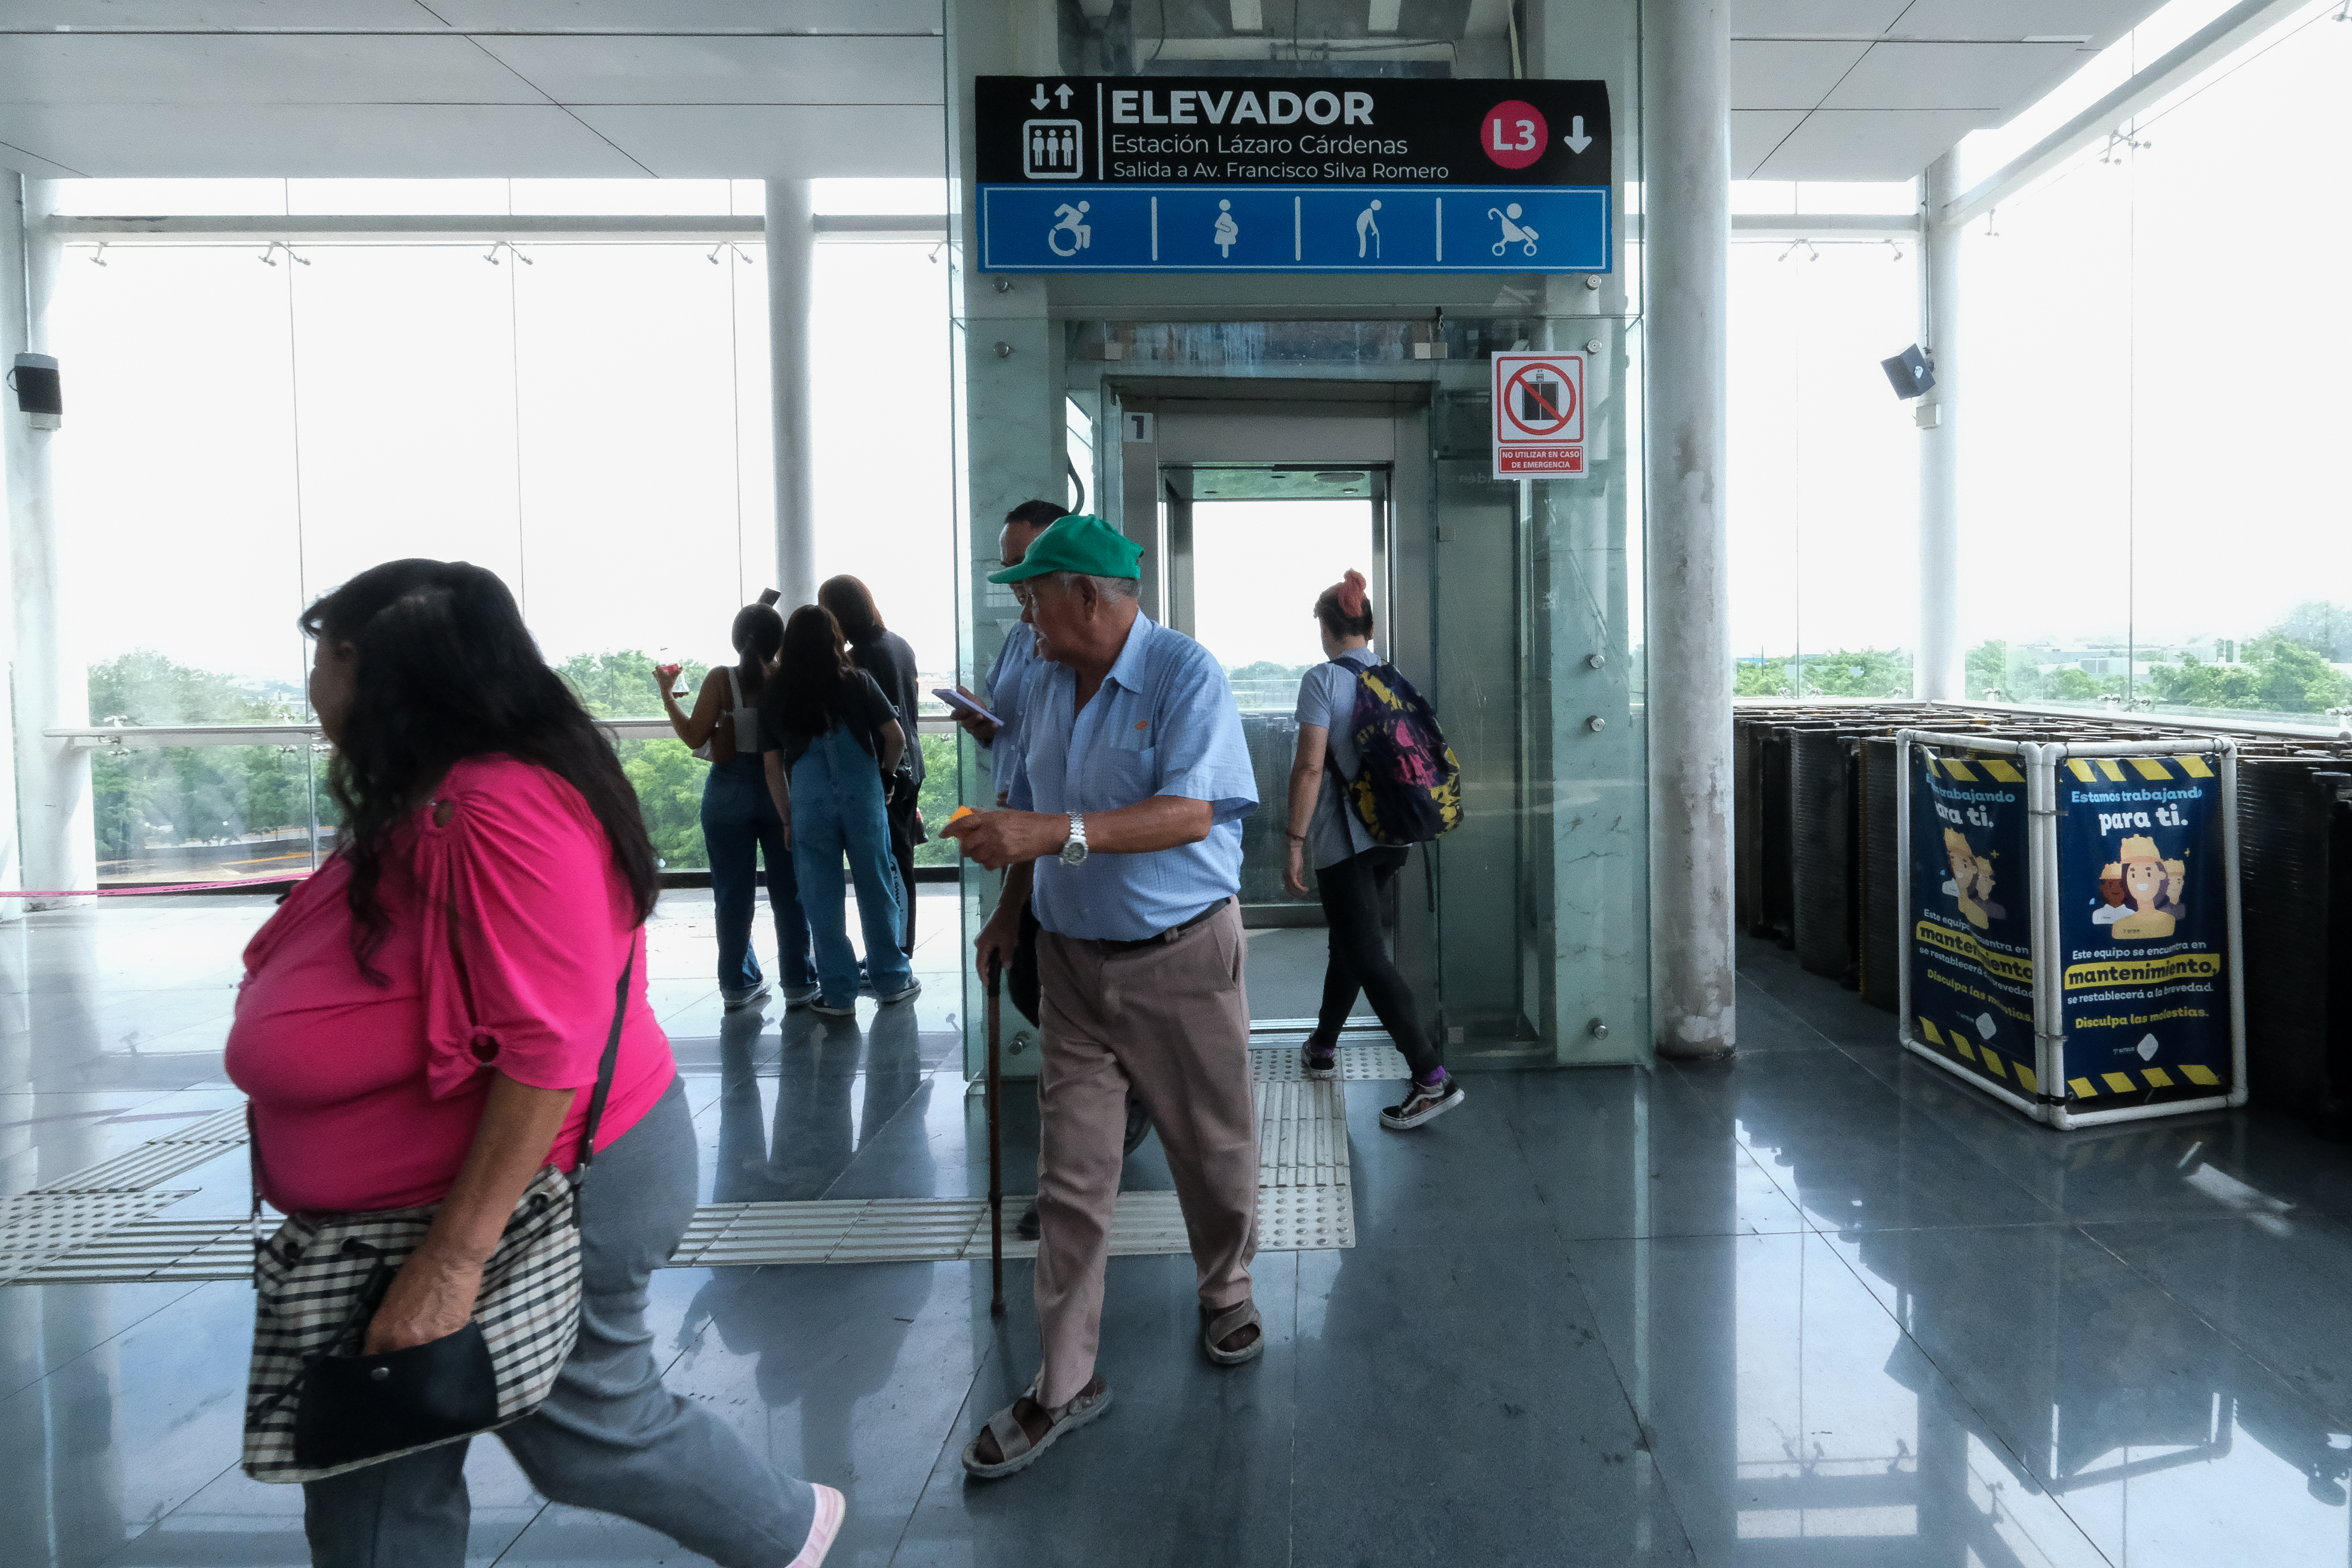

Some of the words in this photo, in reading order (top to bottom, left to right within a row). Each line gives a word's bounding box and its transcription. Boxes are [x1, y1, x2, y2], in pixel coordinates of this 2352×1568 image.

[1112, 91, 1375, 125] ELEVADOR
[1113, 134, 1209, 153] Estación
[1219, 135, 1293, 154] Lázaro
[1300, 136, 1409, 155] Cárdenas
[1493, 118, 1536, 151] L3
[1115, 162, 1172, 178] Salida
[1178, 166, 1188, 178] a
[1194, 163, 1220, 177] Av.
[1228, 162, 1318, 179] Francisco
[1324, 163, 1366, 179] Silva
[1373, 164, 1449, 179] Romero
[1131, 415, 1144, 439] 1
[2071, 791, 2120, 803] Estamos
[1935, 801, 1963, 825] ara
[1967, 805, 1994, 828] ti.
[2098, 811, 2151, 836] para
[2156, 803, 2188, 826] ti.
[1924, 908, 1941, 921] Este
[2015, 946, 2030, 954] en
[1930, 949, 1982, 975] restablecerá
[2073, 950, 2092, 960] Este
[2093, 947, 2130, 959] equipo
[2147, 942, 2189, 955] encuentra
[2191, 941, 2207, 949] en
[1927, 969, 1968, 994] Disculpa
[1970, 986, 1986, 1000] las
[2068, 958, 2217, 985] mantenimiento,
[2079, 989, 2145, 1003] restablecerá
[2155, 988, 2163, 997] la
[2076, 1015, 2128, 1029] Disculpa
[2130, 1014, 2148, 1025] las
